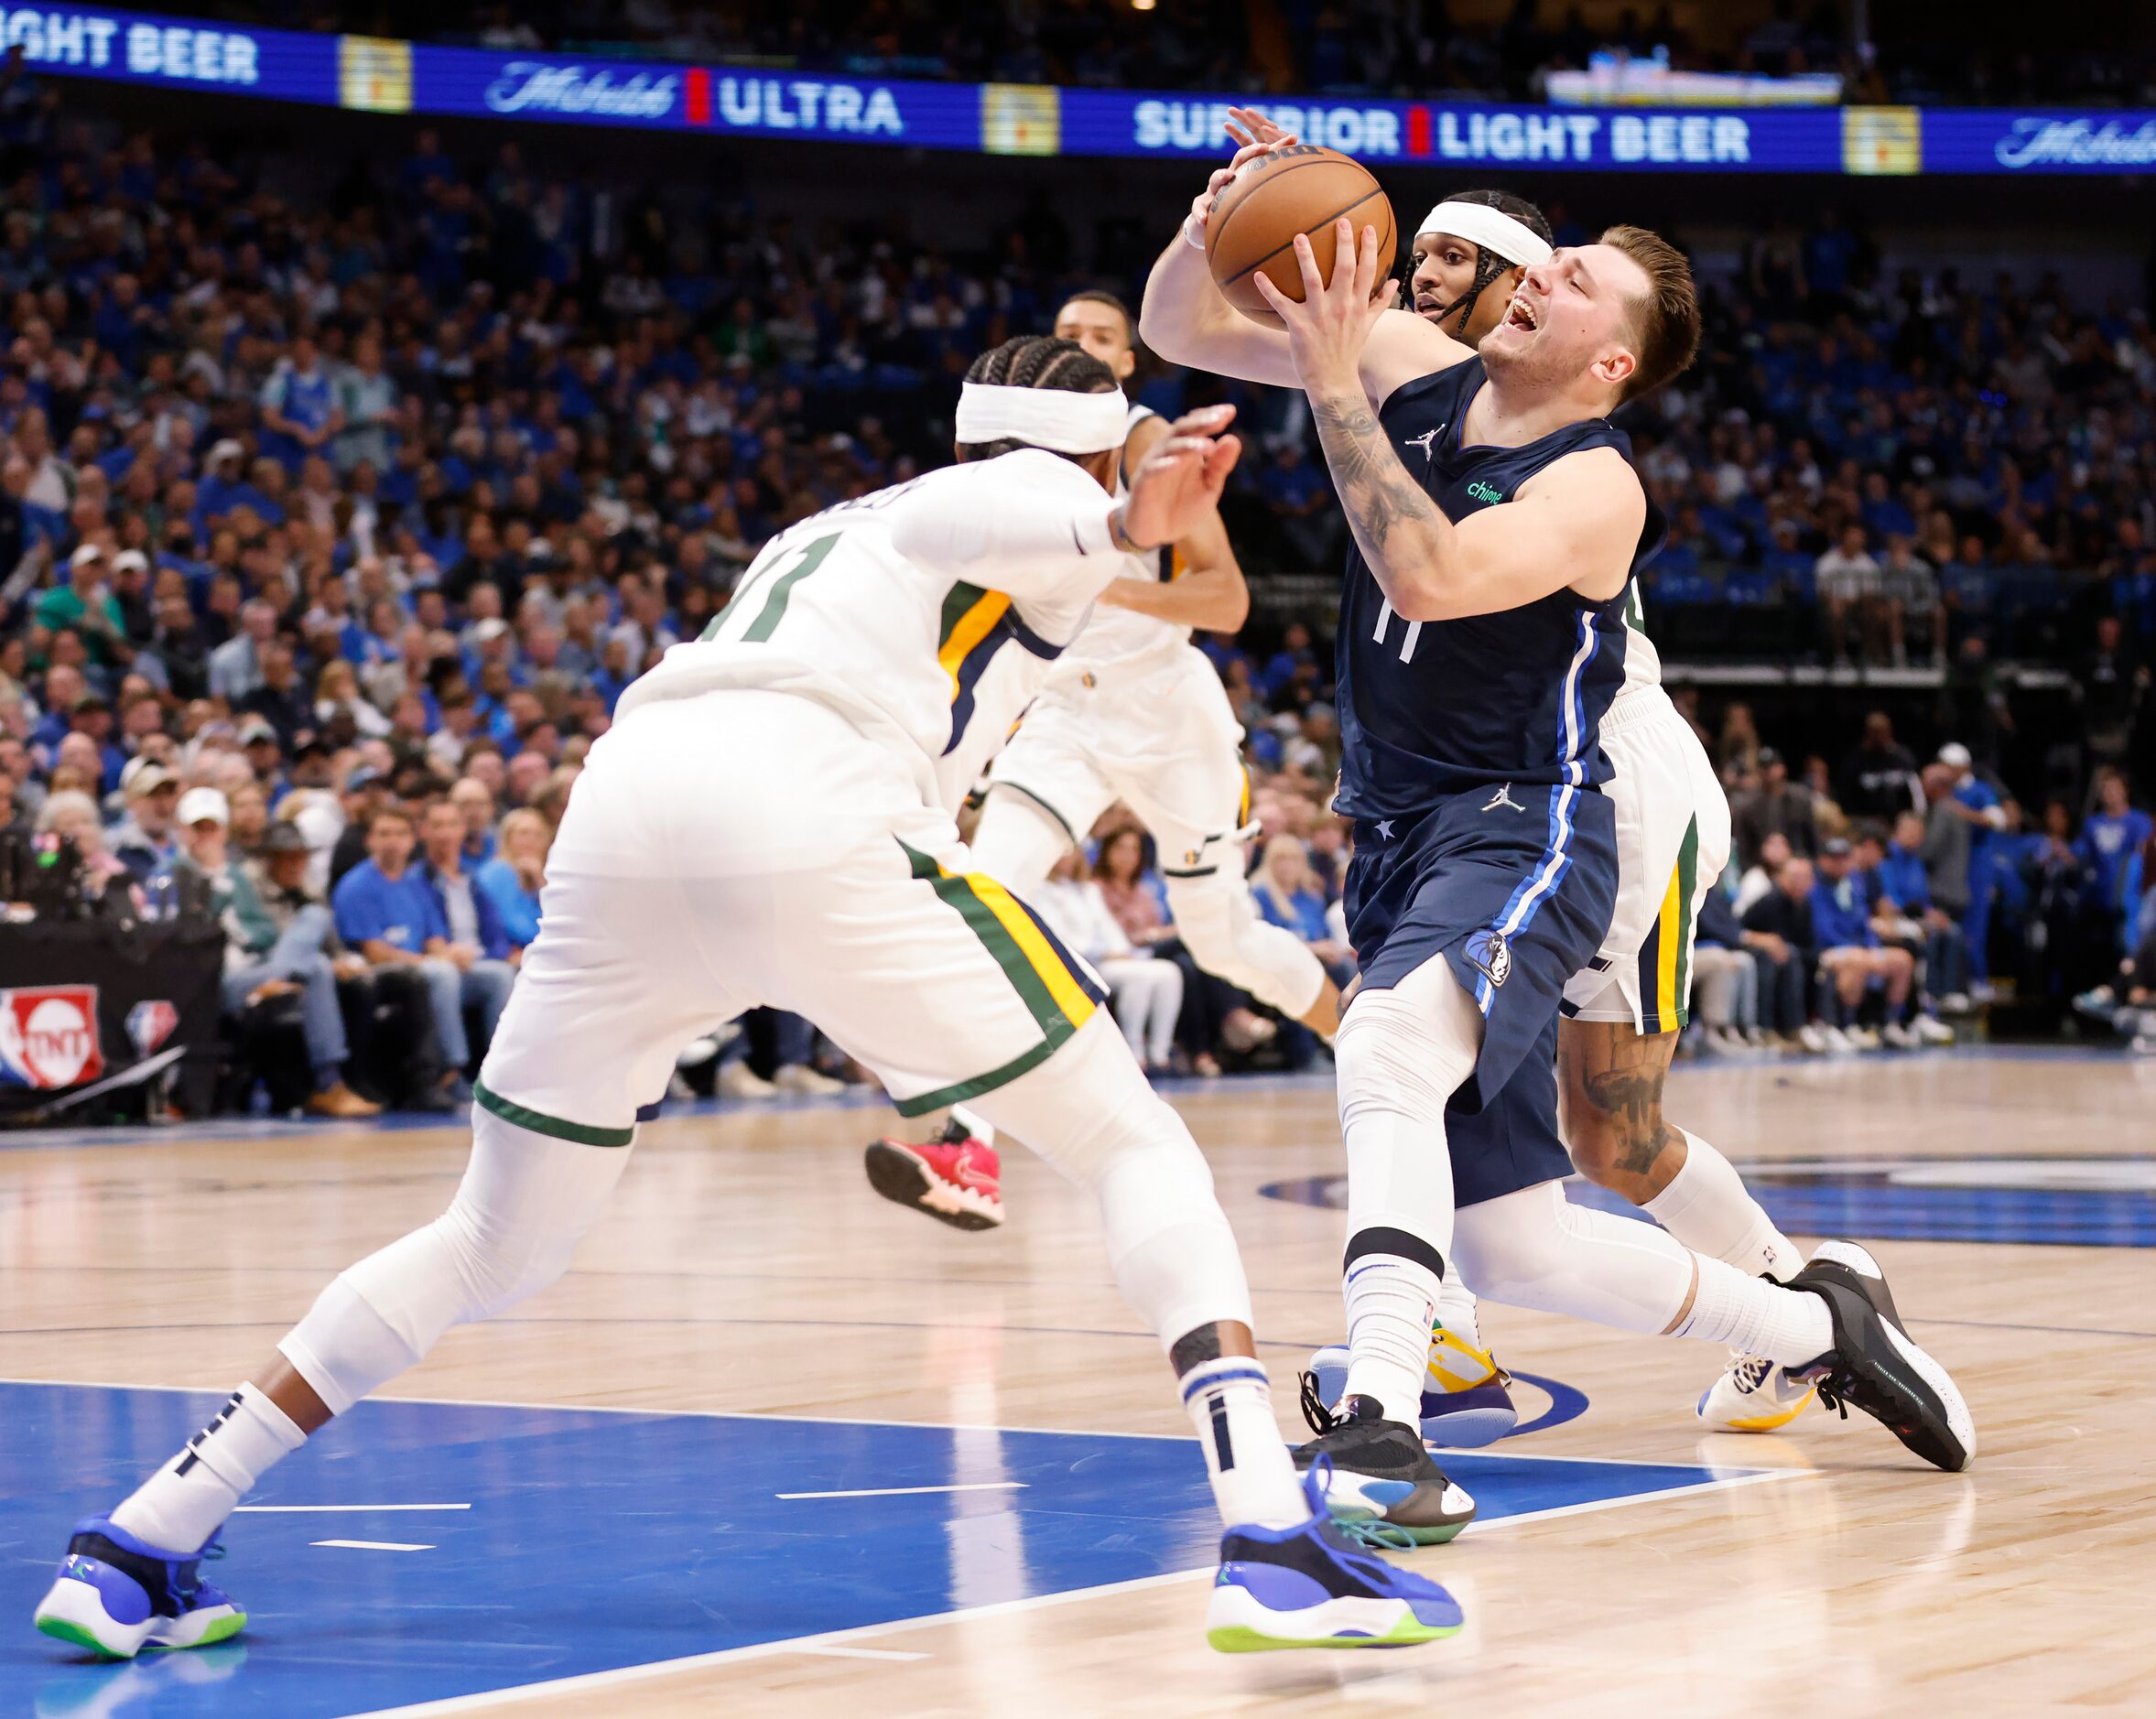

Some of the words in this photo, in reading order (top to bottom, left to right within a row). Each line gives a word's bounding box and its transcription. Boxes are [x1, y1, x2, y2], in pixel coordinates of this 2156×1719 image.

[126, 23, 258, 84] BEER
[720, 77, 904, 135] ULTRA
[1439, 112, 1600, 161] LIGHT
[1610, 115, 1750, 163] BEER
[1468, 481, 1502, 504] chime
[27, 1029, 90, 1059] TNT
